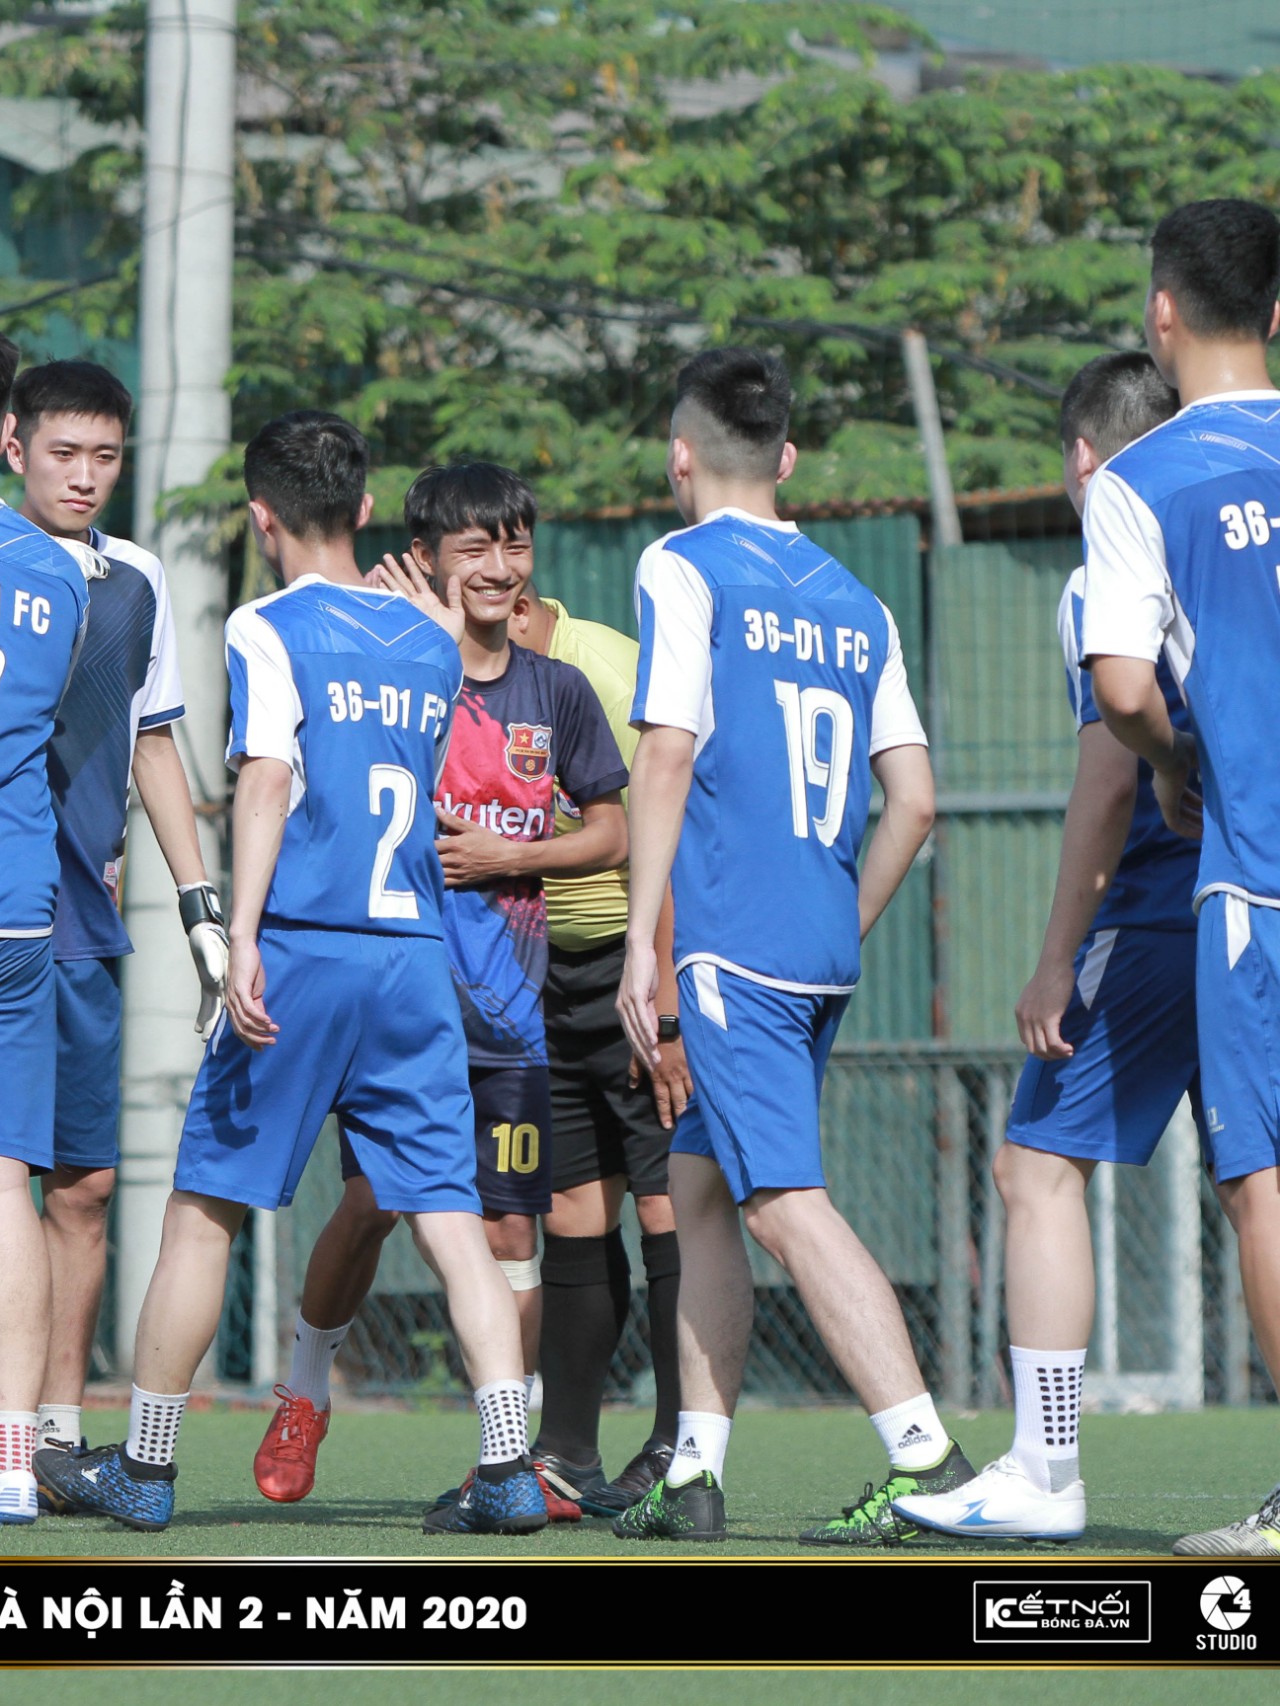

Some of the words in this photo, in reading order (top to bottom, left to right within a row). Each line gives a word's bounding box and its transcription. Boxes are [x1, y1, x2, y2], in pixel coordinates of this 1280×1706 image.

[14, 590, 51, 635] FC
[744, 608, 825, 664] 36-D1
[836, 626, 870, 673] FC
[327, 680, 411, 729] 36-D1
[773, 679, 854, 848] 19
[433, 793, 545, 836] kuten
[368, 763, 420, 920] 2
[491, 1122, 540, 1174] 10
[898, 1433, 932, 1449] adidas
